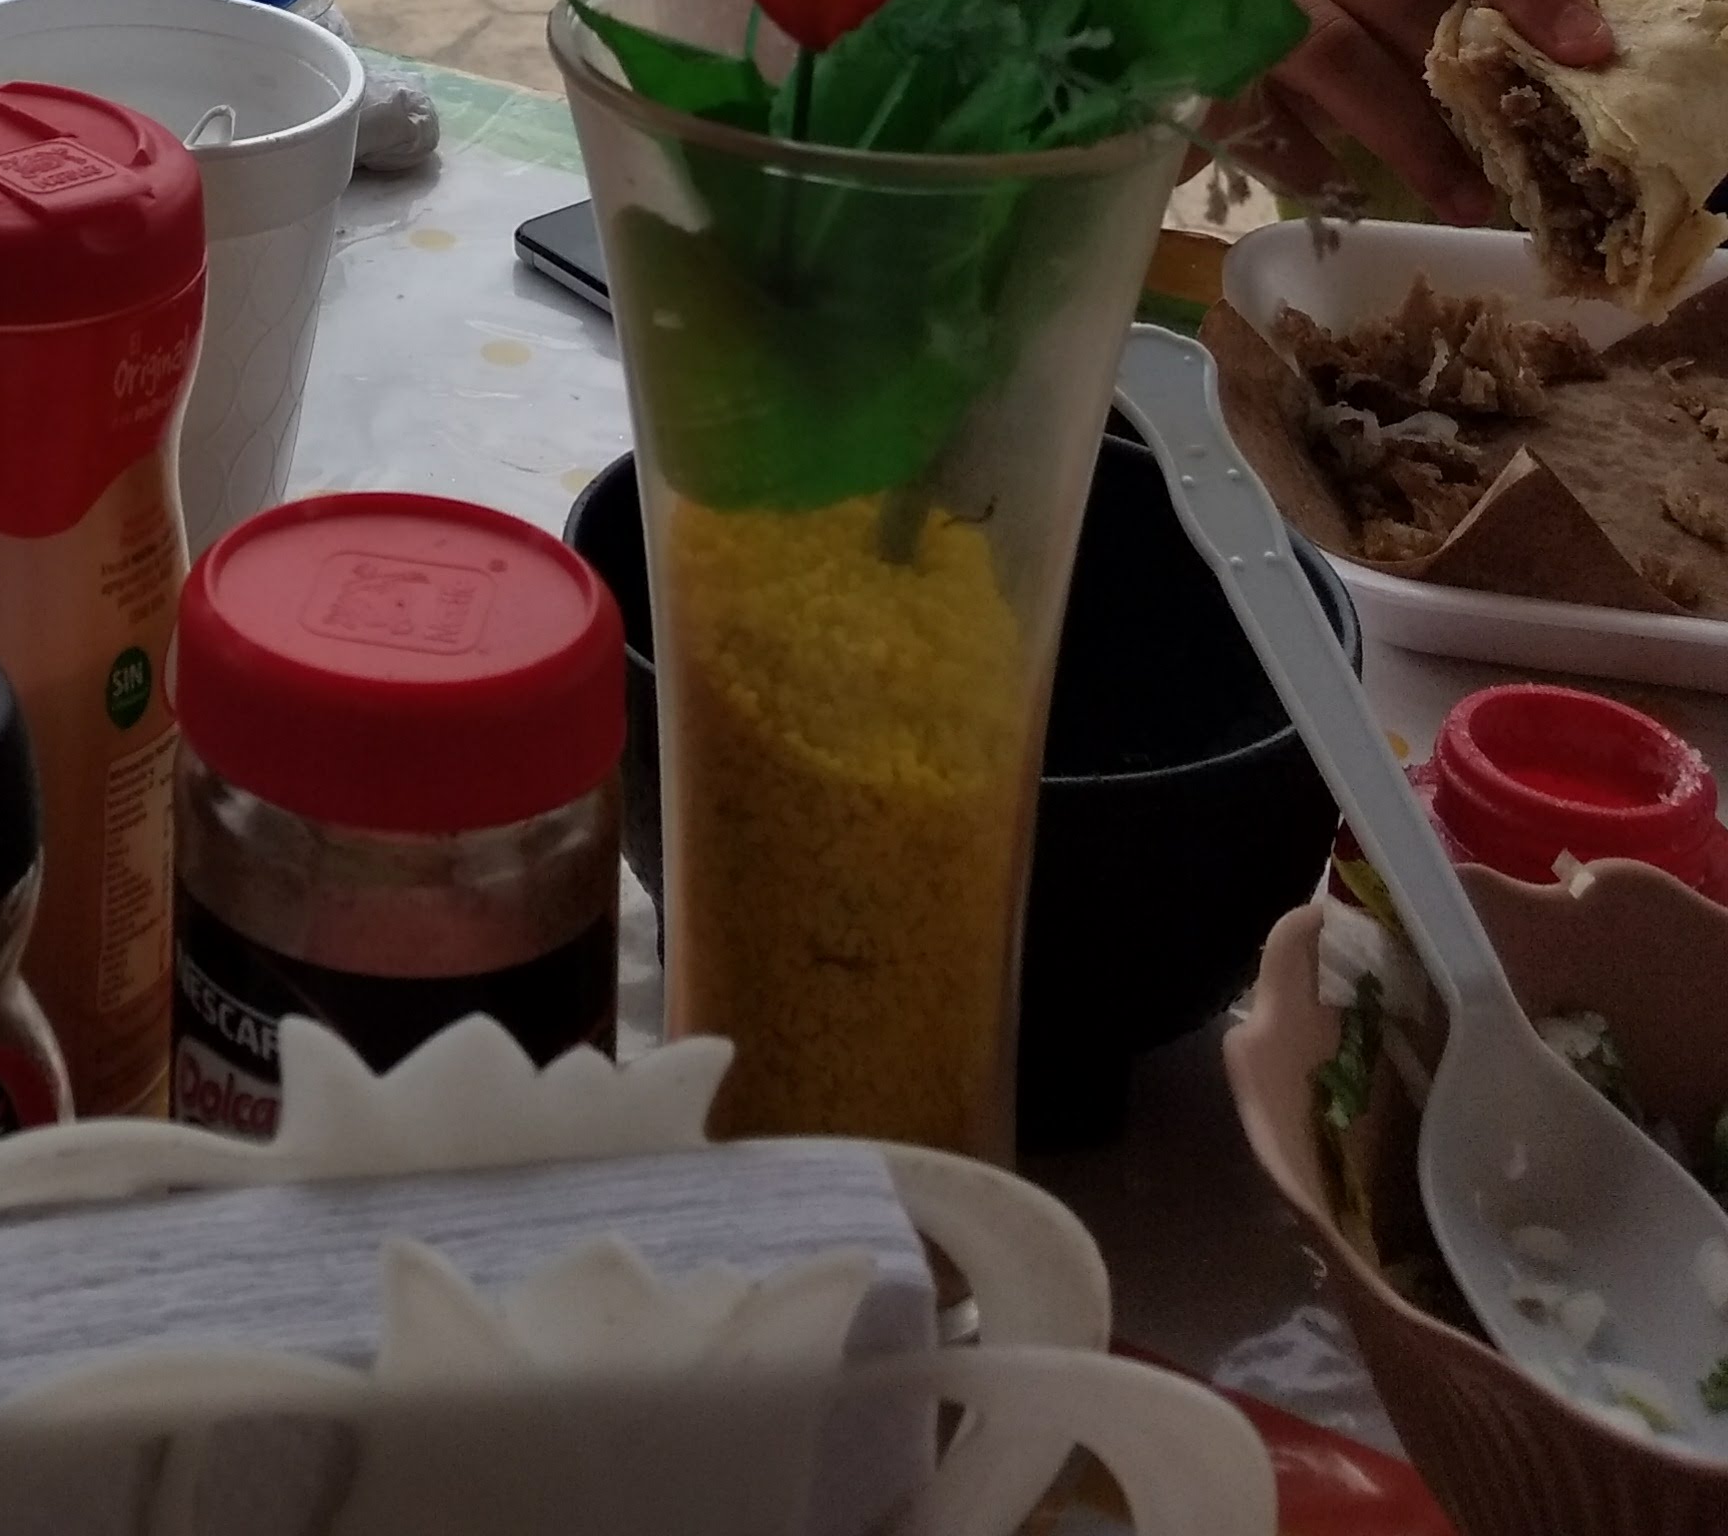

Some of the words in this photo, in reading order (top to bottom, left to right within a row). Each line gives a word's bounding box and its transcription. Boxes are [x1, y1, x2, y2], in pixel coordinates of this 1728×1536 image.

[111, 662, 145, 699] SIN
[175, 937, 277, 1062] NESCAF
[180, 1051, 277, 1136] Dolca
